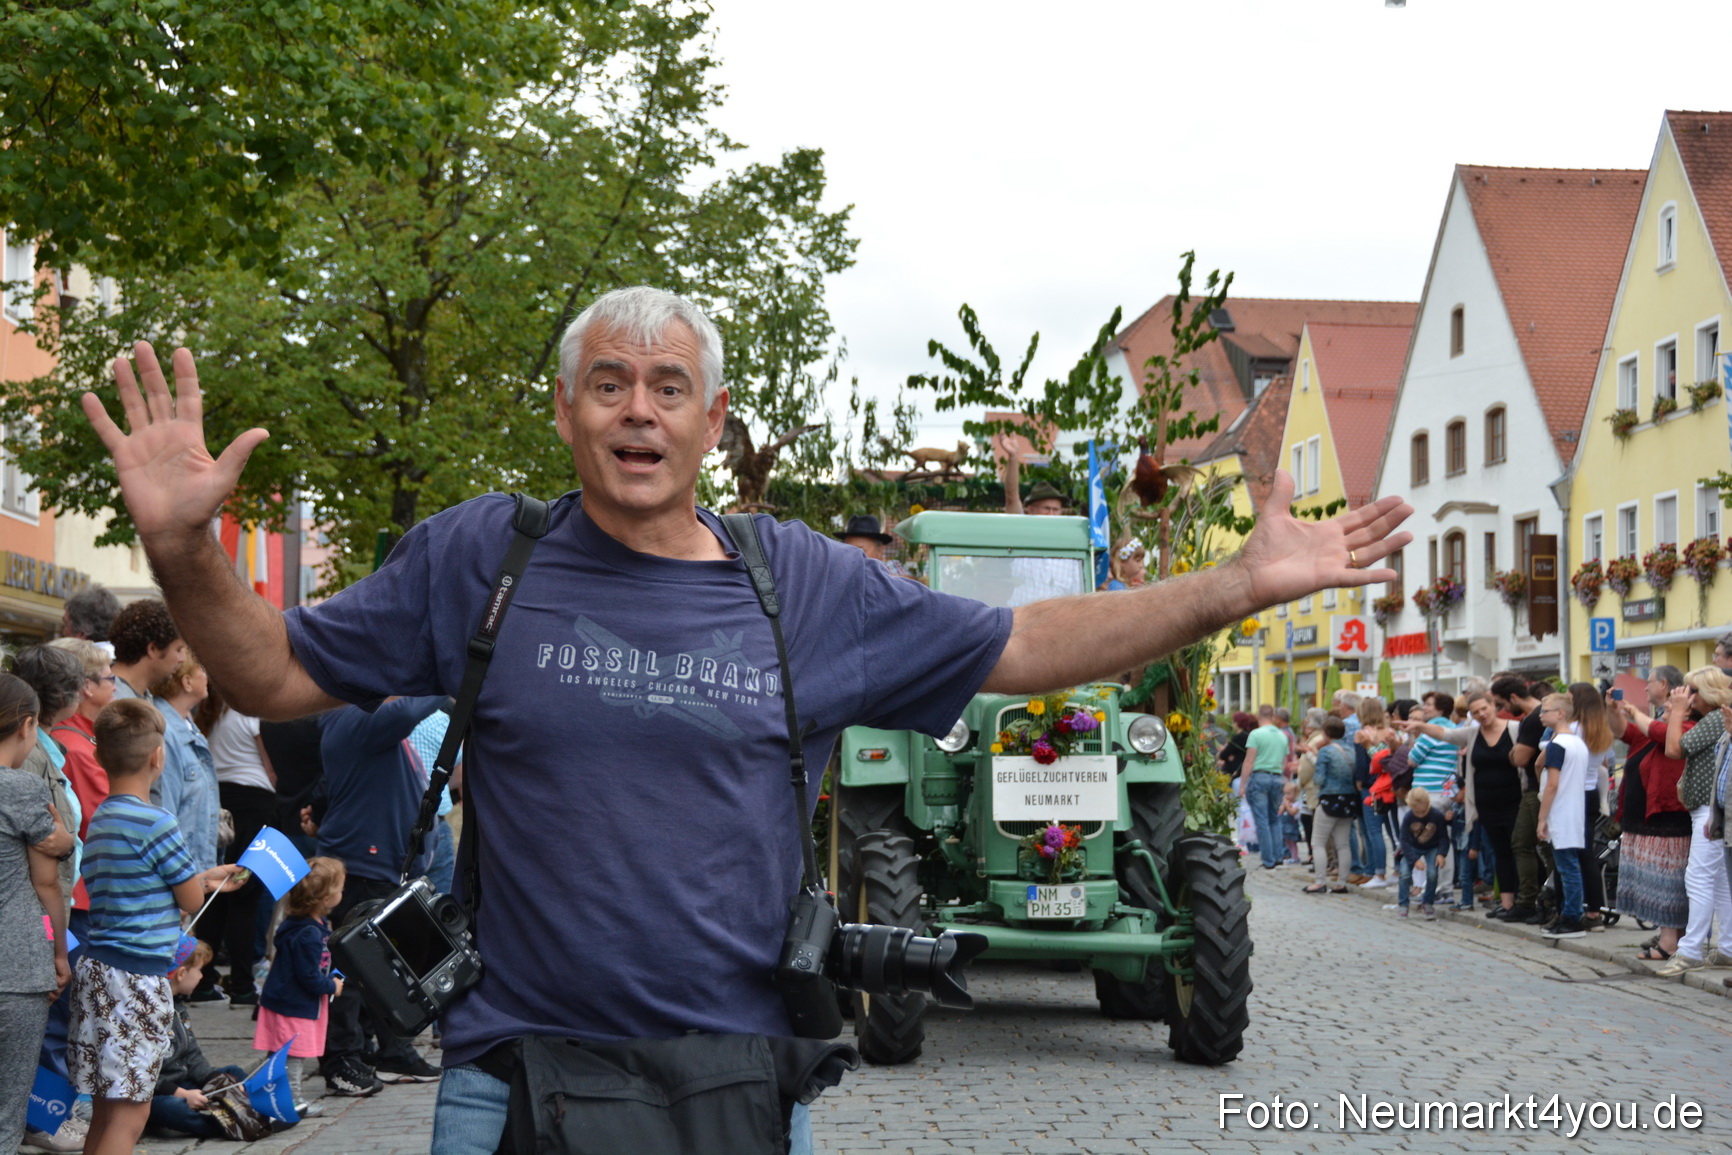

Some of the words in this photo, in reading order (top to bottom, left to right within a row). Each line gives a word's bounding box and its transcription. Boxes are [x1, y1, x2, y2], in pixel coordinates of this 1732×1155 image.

[486, 586, 508, 630] tamrac
[1595, 621, 1610, 649] P
[537, 643, 660, 677] FOSSIL
[675, 653, 778, 697] BRAND
[560, 674, 580, 684] LOS
[587, 675, 637, 689] ANGELES
[648, 681, 696, 695] CHICAGO
[707, 688, 729, 701] NEW
[735, 692, 758, 706] YORK
[997, 768, 1108, 783] GEFLÜGELZUCHTVEREIN
[1025, 794, 1080, 806] NEUMARKT
[265, 846, 296, 883] Lebenshilfe
[1038, 887, 1058, 901] NM
[1031, 903, 1050, 916] PM
[1054, 902, 1072, 916] 35
